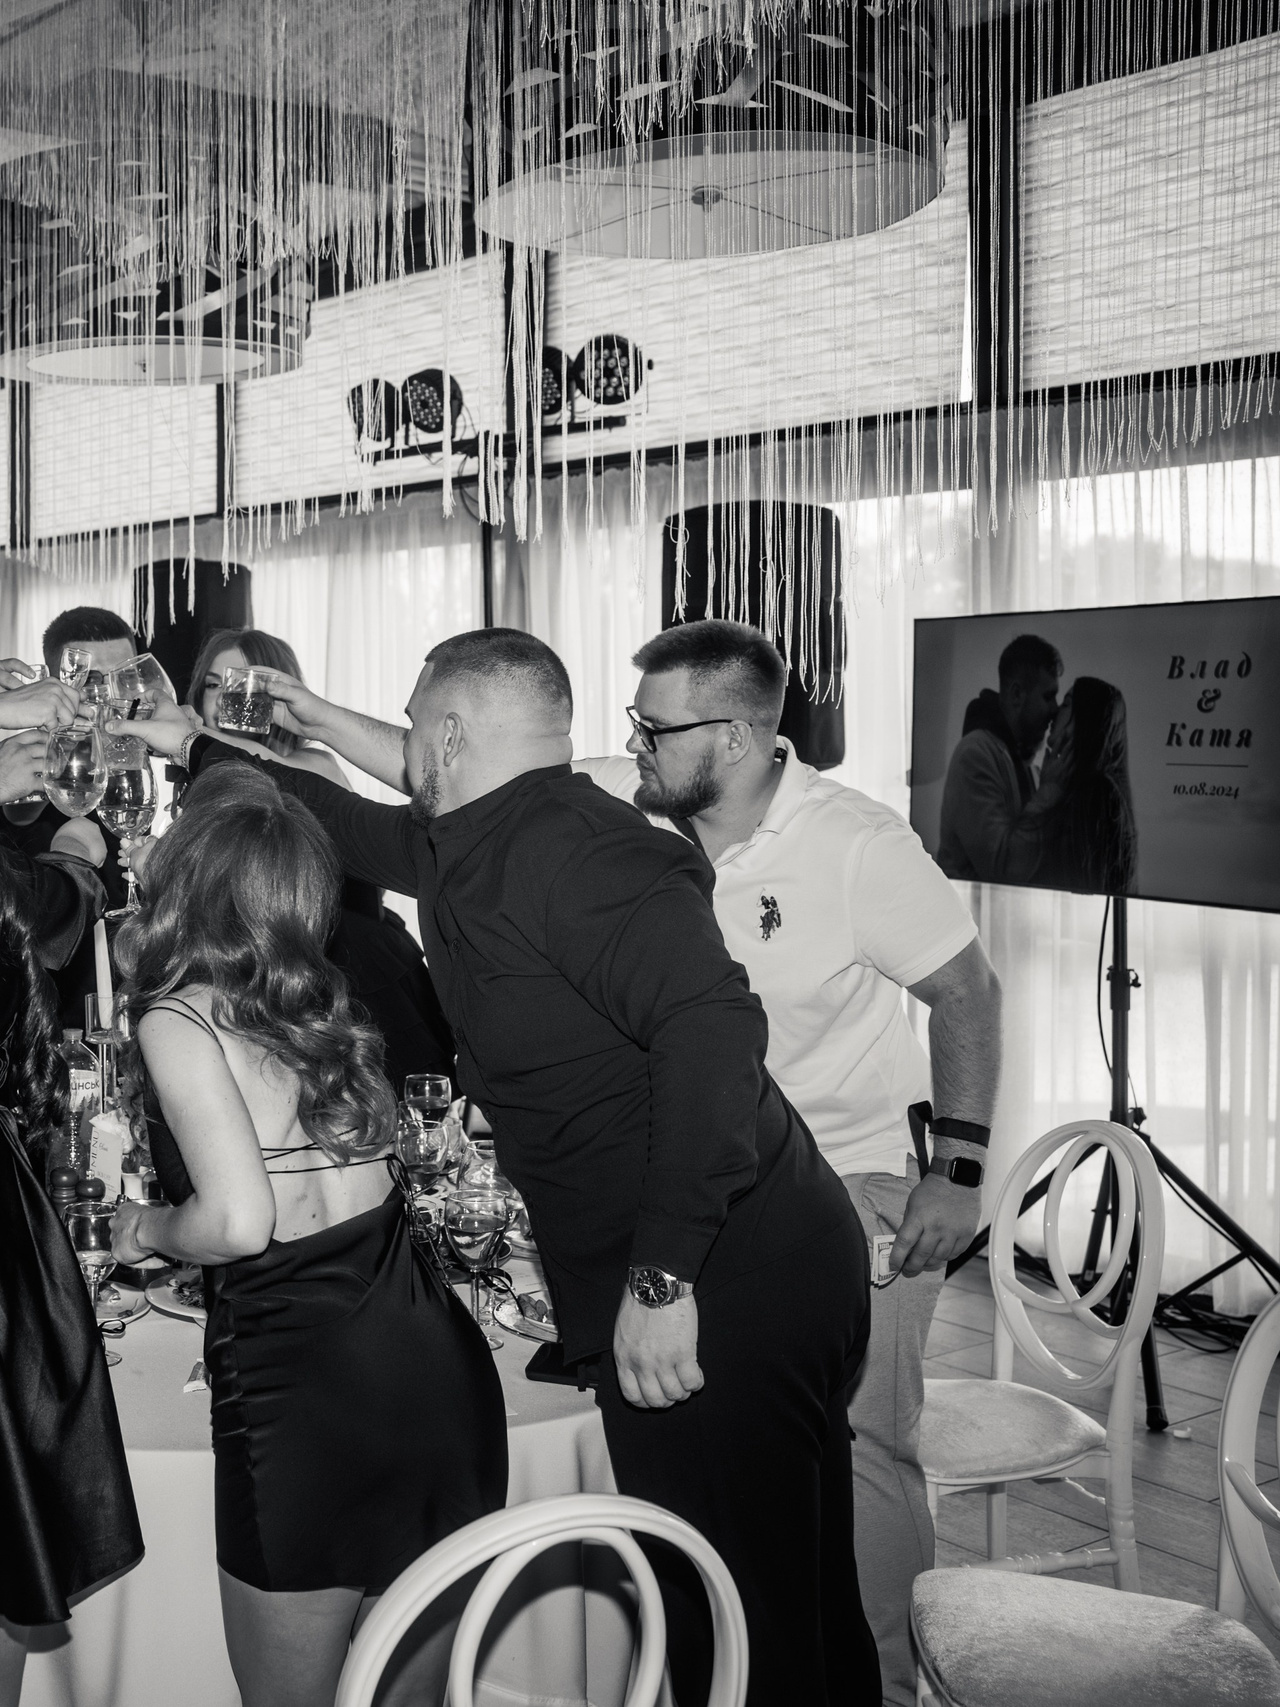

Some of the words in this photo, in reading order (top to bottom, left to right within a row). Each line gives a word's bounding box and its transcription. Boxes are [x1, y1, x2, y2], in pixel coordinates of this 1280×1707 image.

[1167, 651, 1252, 680] Влад
[1196, 688, 1222, 713] &
[1165, 722, 1253, 748] Катя
[1172, 782, 1239, 799] 10.08.2024
